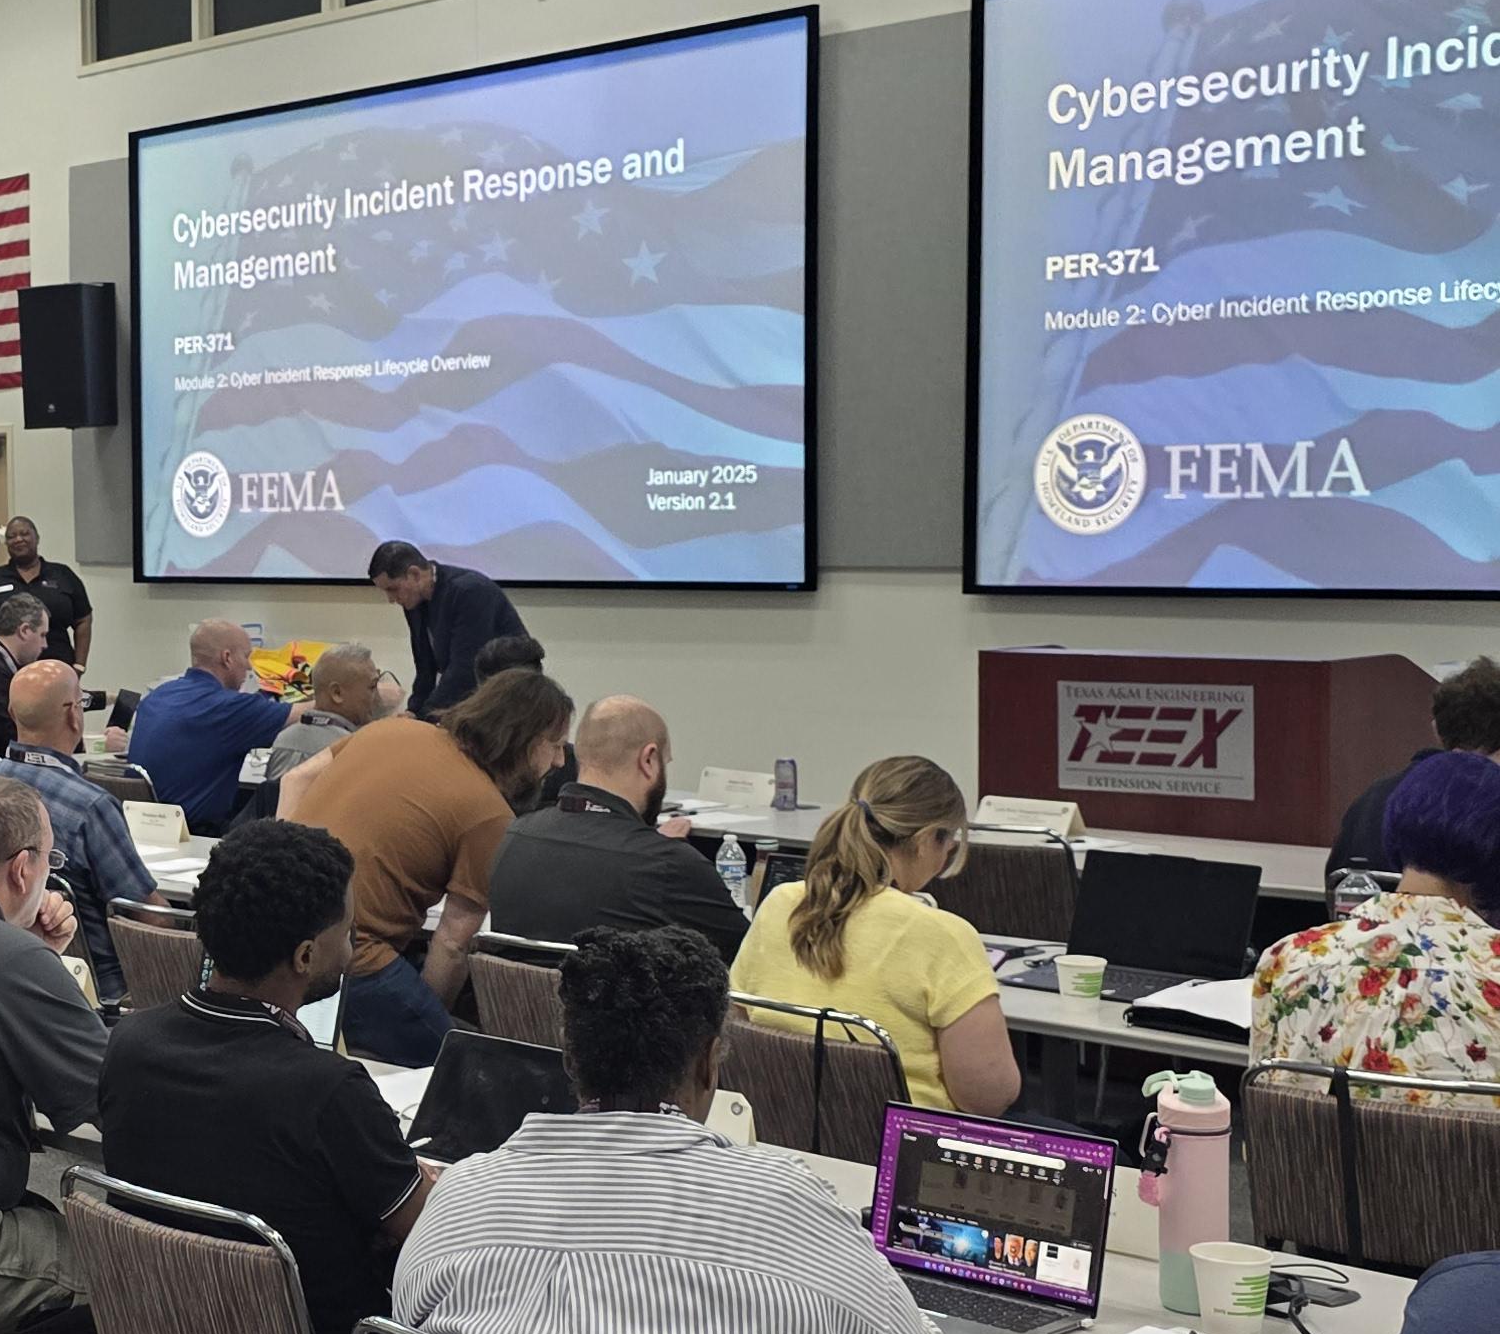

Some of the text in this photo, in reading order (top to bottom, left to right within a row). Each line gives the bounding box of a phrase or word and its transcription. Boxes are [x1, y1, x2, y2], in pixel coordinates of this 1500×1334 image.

[1048, 47, 1370, 130] Cybersecurity
[1047, 114, 1367, 191] Management
[173, 139, 686, 248] Cybersecurity Incident Response and
[174, 243, 337, 291] Management
[1045, 247, 1160, 281] PER-371
[1044, 306, 1120, 332] Module
[1125, 303, 1146, 326] 2:
[1151, 300, 1214, 327] Cyber
[1219, 293, 1308, 319] Incident
[1316, 285, 1432, 314] Response
[174, 332, 235, 355] PER-371
[174, 353, 491, 392] Module 2: Cyber Incident Response Lifecycle Overview
[238, 469, 345, 514] FEMA
[645, 464, 758, 488] January 2025
[1163, 438, 1371, 501] FEMA
[645, 491, 737, 511] Version 2.1
[1064, 685, 1245, 703] TEXAS A&M ENGINEERING
[1067, 704, 1244, 769] TEEX
[1086, 775, 1221, 795] EXTENSION SERVICE
